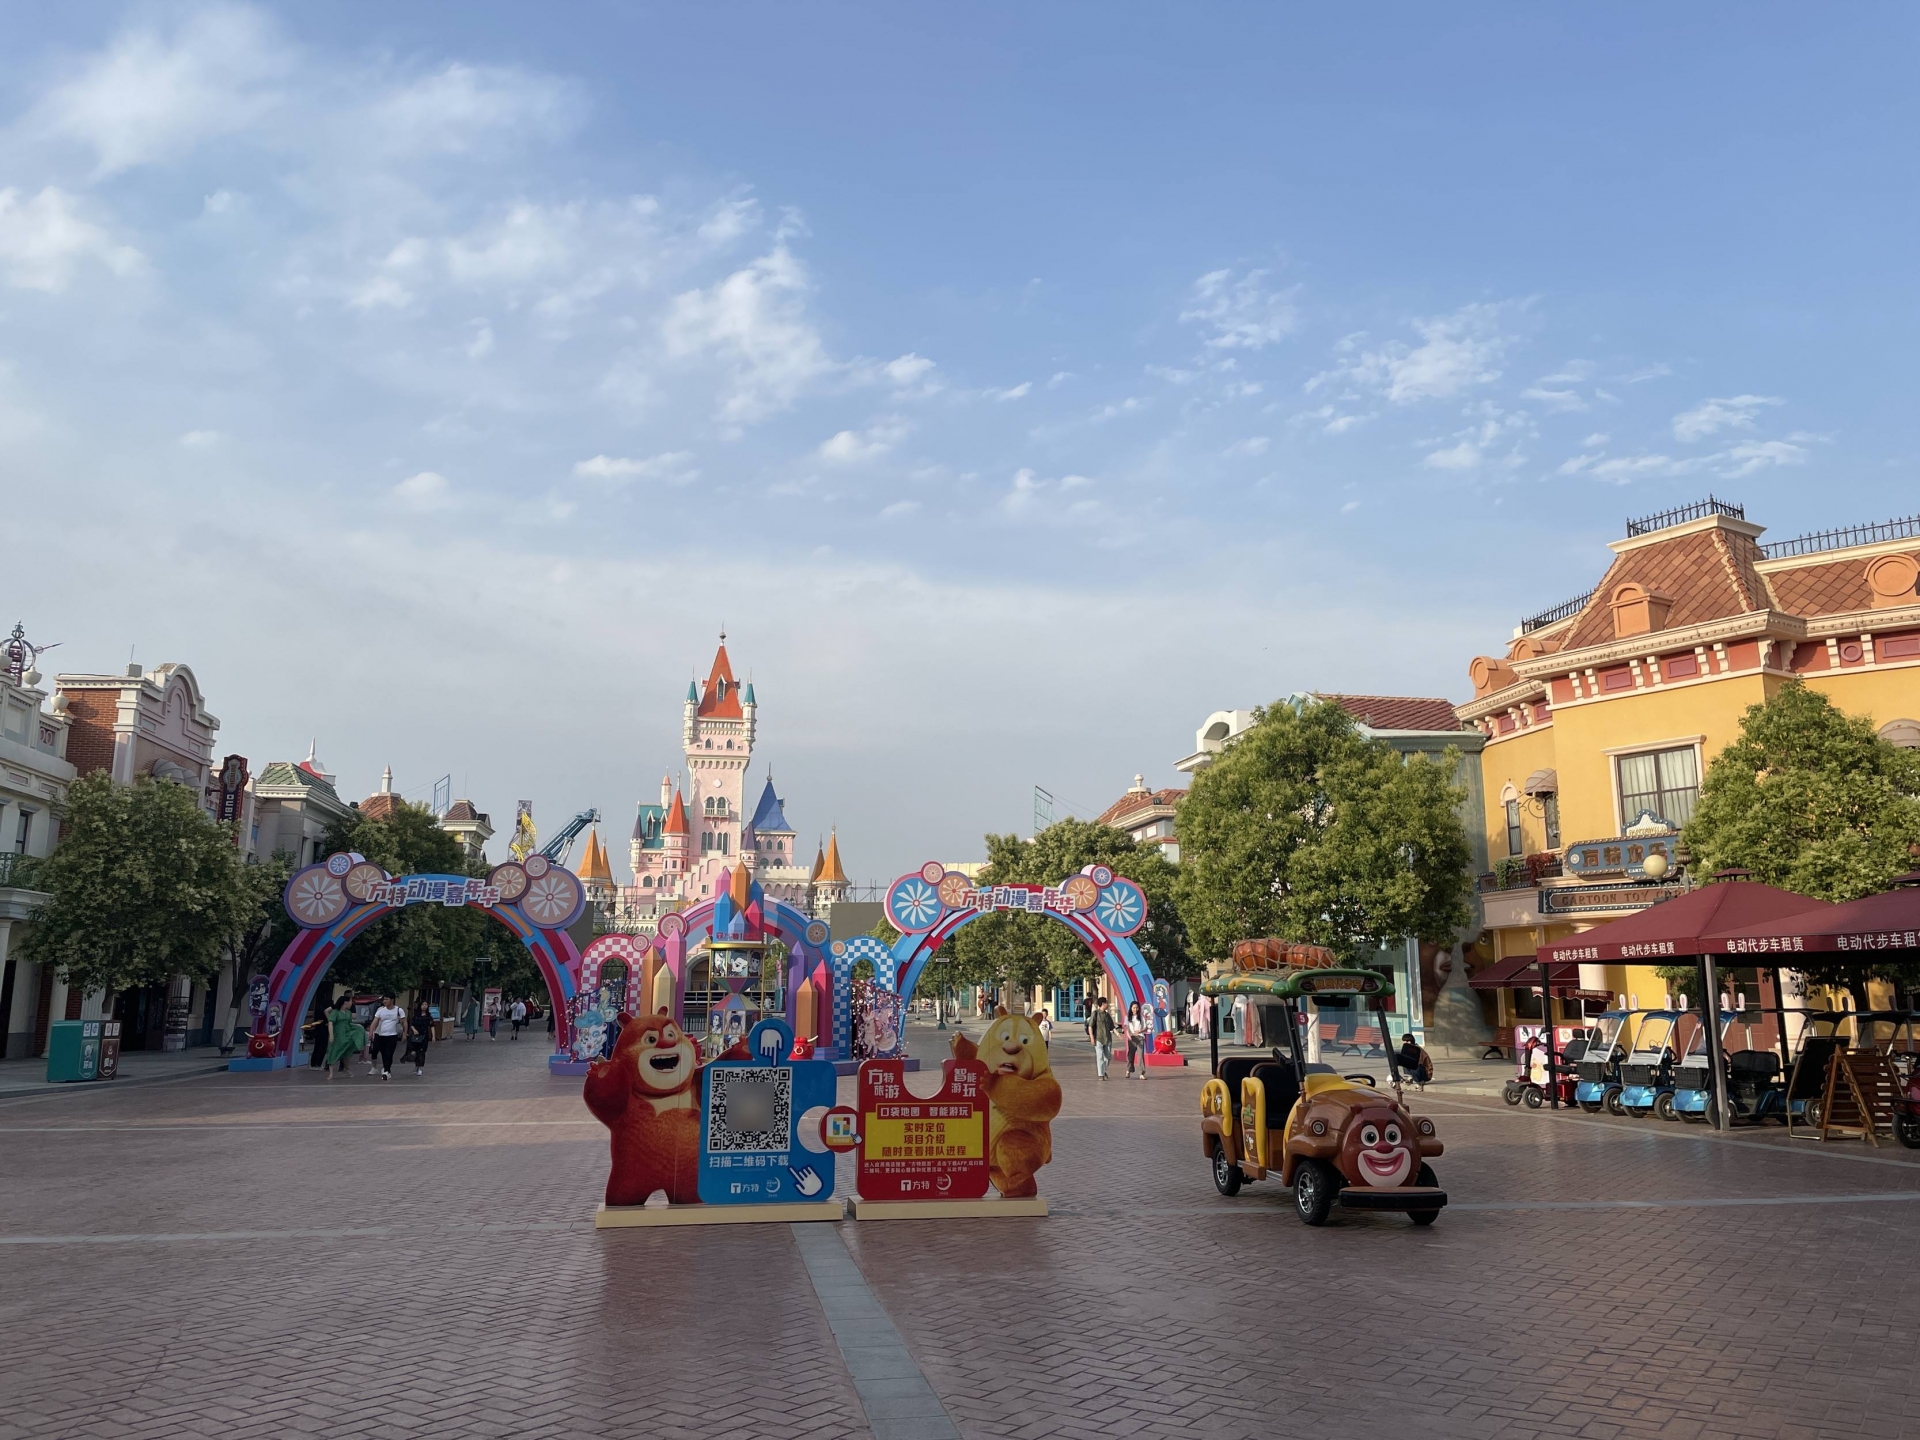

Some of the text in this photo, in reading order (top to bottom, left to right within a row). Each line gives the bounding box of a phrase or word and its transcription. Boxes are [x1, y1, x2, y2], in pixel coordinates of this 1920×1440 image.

[367, 879, 499, 906] 方特动漫嘉年华
[1562, 893, 1617, 906] CARTOON
[1624, 890, 1650, 902] TOY
[961, 888, 1075, 914] 方特动漫嘉年华
[1726, 936, 1804, 954] 电动代步车租赁
[1837, 931, 1920, 951] 电动代步车租
[1553, 947, 1599, 962] 电动代步车租赁
[1621, 941, 1675, 957] 电动代步车租赁
[868, 1068, 895, 1085] 方特
[954, 1068, 977, 1083] 智能
[874, 1084, 900, 1099] 旅游
[951, 1082, 976, 1097] 游玩
[880, 1106, 969, 1117] 口袋地图 智能游玩
[904, 1122, 946, 1133] 实时定位
[904, 1134, 946, 1145] 项目介绍
[882, 1145, 967, 1157] 随时查看排队进程
[709, 1154, 789, 1168] 扫描二维码下载
[742, 1184, 760, 1193] 方特
[912, 1181, 930, 1191] 方特
